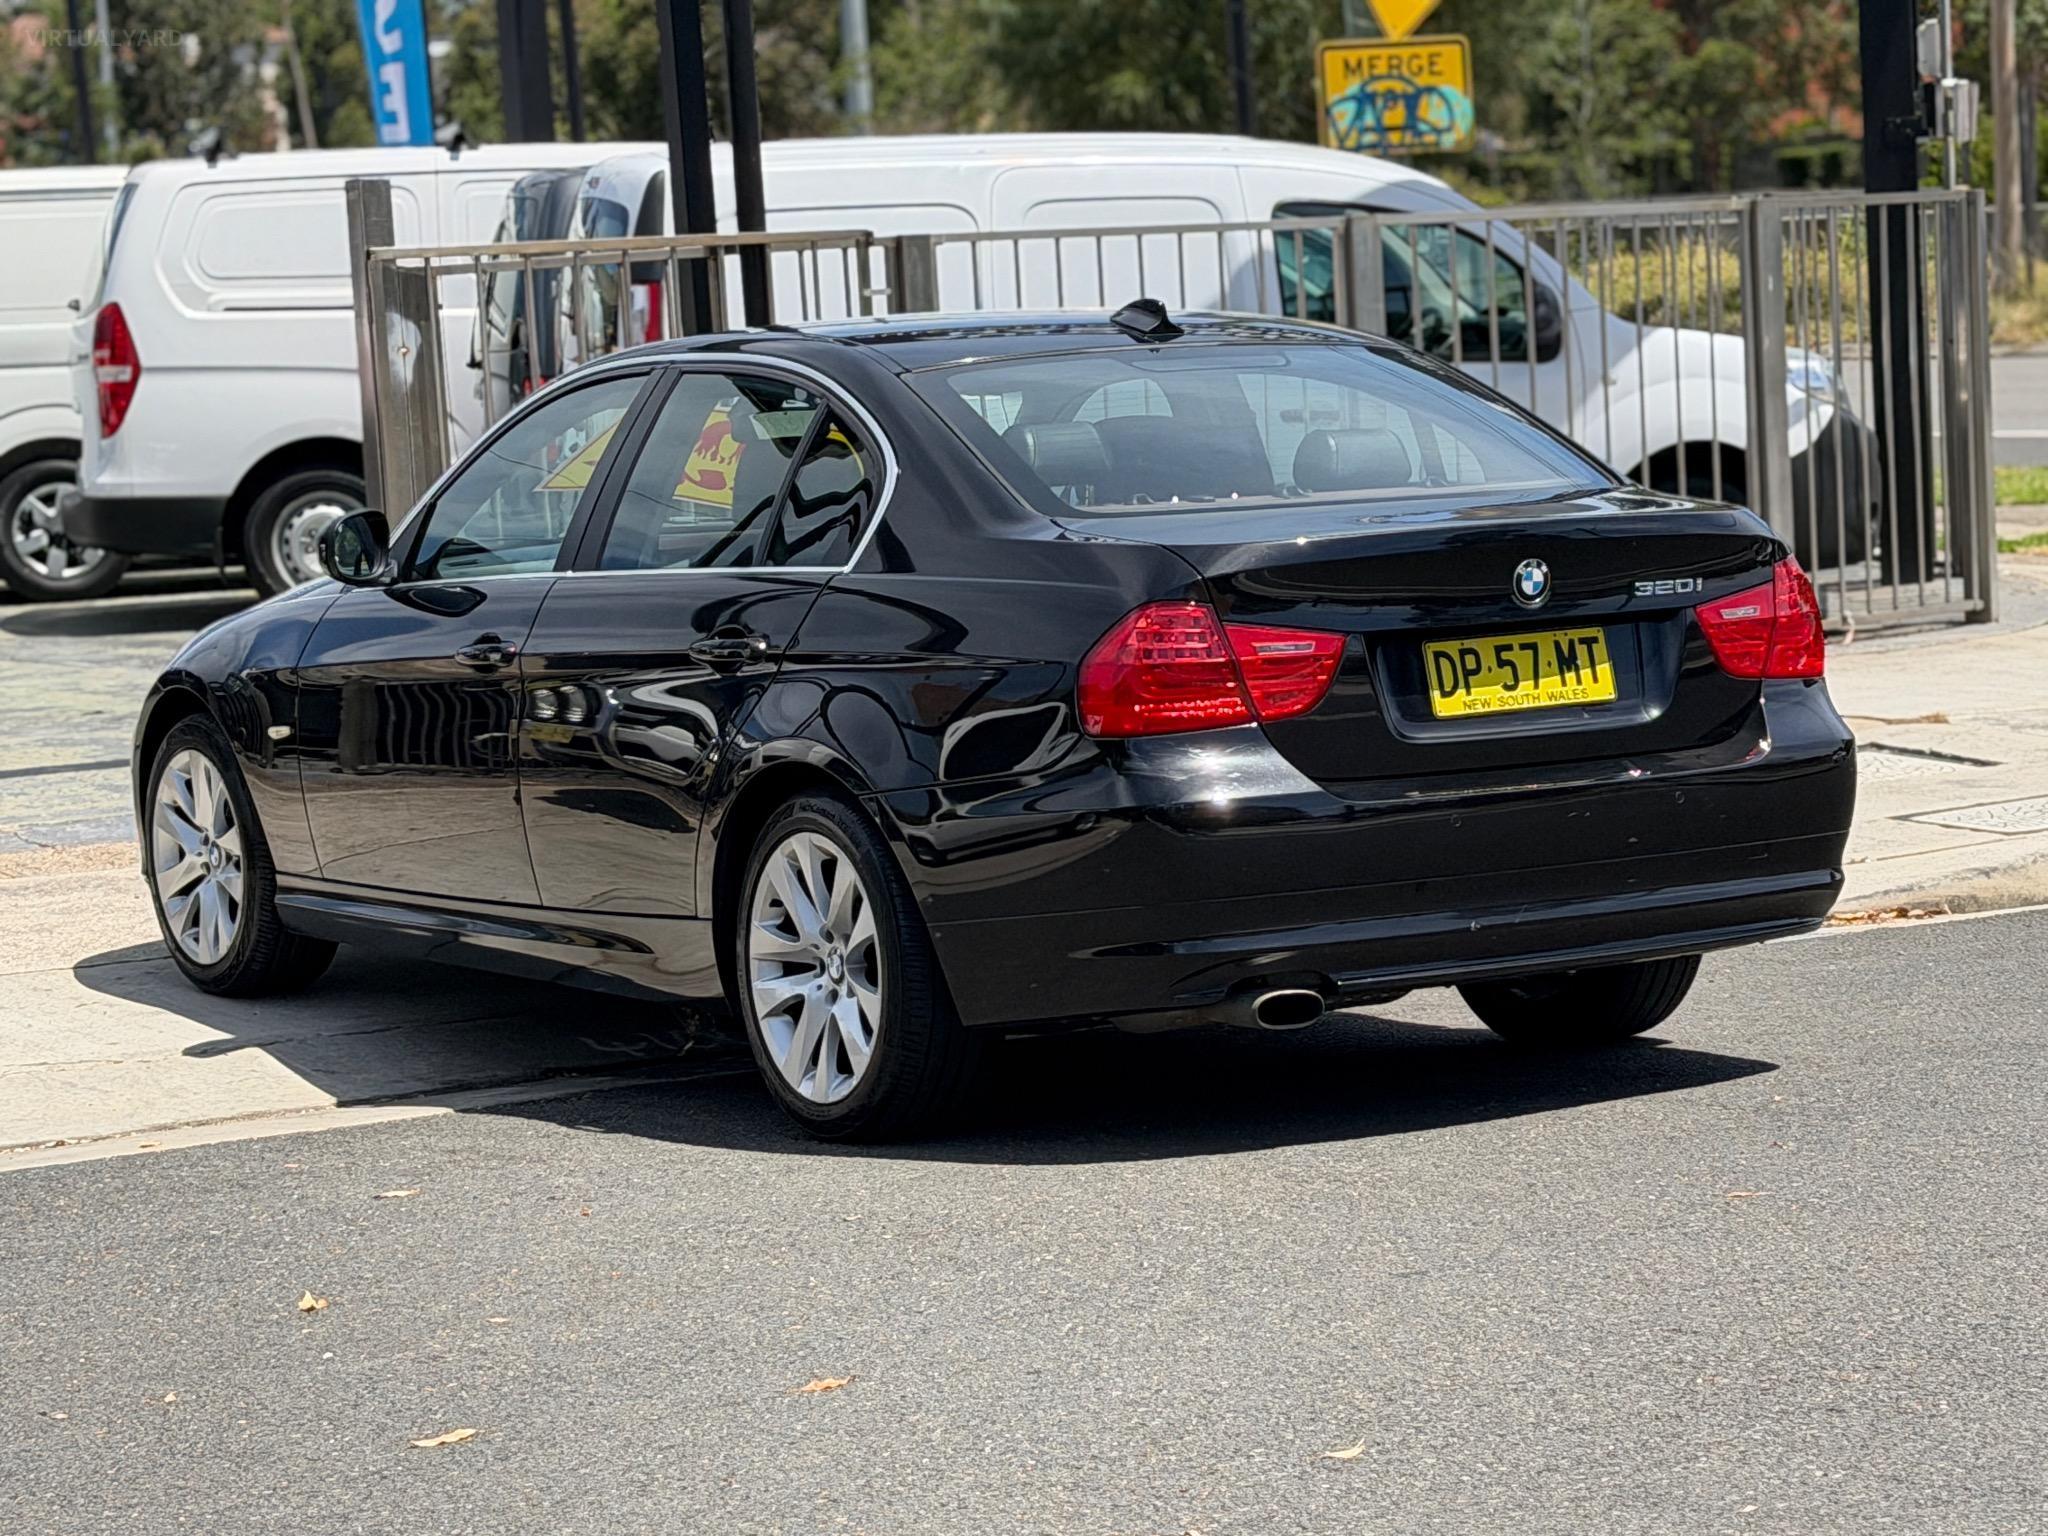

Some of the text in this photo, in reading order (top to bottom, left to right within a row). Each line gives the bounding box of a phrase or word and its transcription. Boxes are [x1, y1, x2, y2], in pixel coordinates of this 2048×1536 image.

[1342, 52, 1444, 79] MERGE
[1462, 687, 1590, 711] NEW SOUTH WALES
